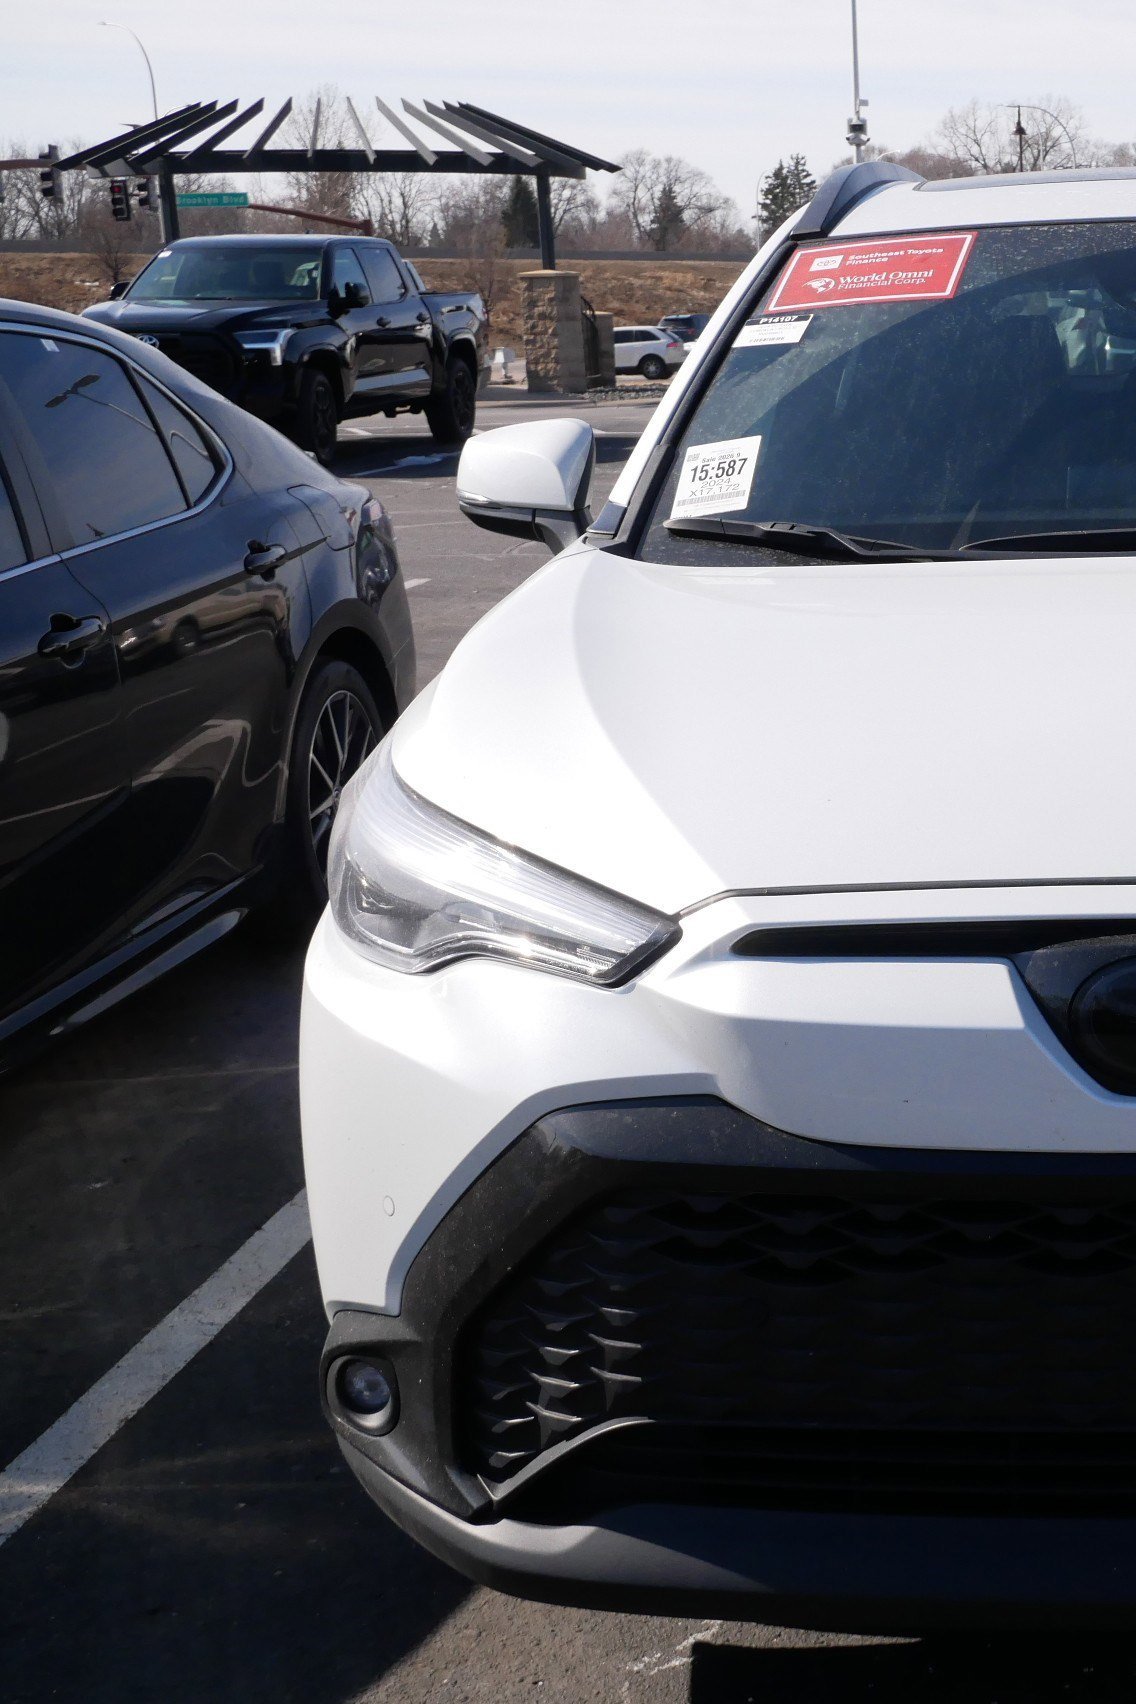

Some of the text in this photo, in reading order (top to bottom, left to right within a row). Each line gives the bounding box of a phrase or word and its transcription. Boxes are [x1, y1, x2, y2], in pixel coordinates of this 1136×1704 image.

[176, 196, 244, 205] Brooklyn Blvd
[848, 250, 905, 260] Southeast
[846, 257, 888, 266] Finance
[839, 269, 934, 283] World Omni
[838, 277, 926, 290] Financial Corp.
[759, 315, 799, 324] P14107
[702, 456, 717, 464] Sale
[691, 459, 748, 482] 15:587
[700, 478, 732, 488] 2024
